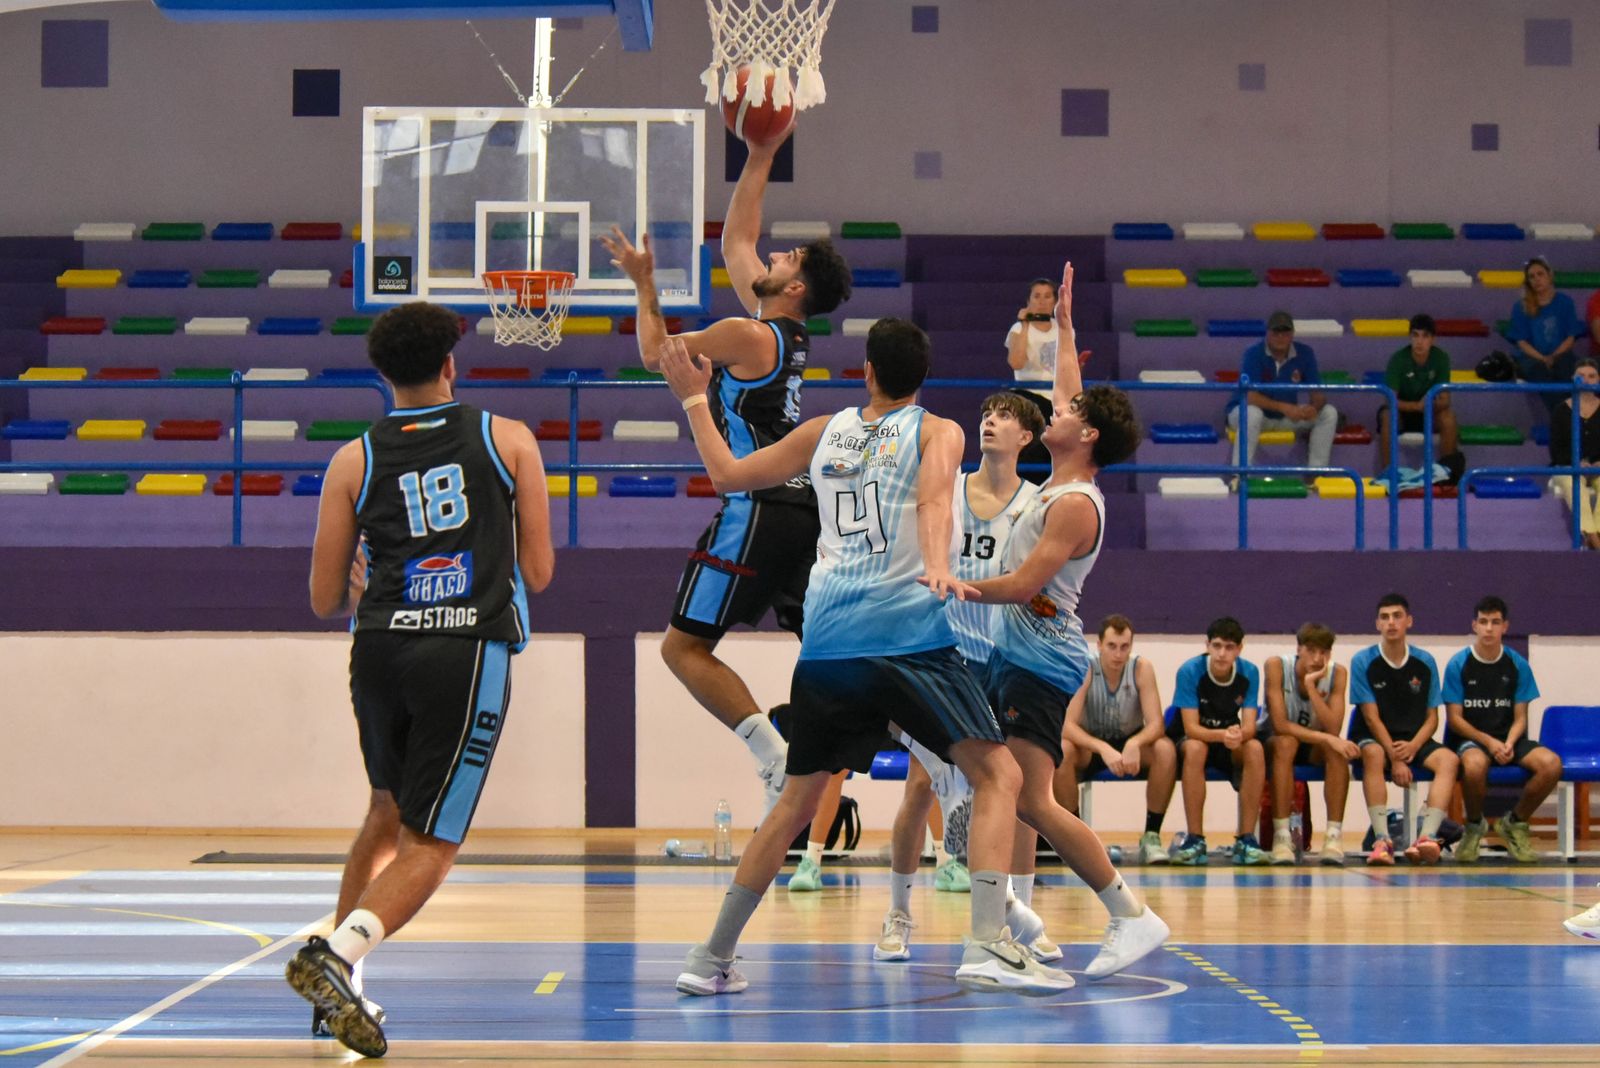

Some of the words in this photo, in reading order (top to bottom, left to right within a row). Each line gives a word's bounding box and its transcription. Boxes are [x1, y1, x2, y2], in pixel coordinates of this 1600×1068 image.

[399, 463, 469, 537] 18
[836, 481, 887, 554] 4
[961, 532, 996, 560] 13
[409, 572, 467, 601] UBAGO
[423, 607, 478, 629] STROG
[463, 710, 498, 768] ULB
